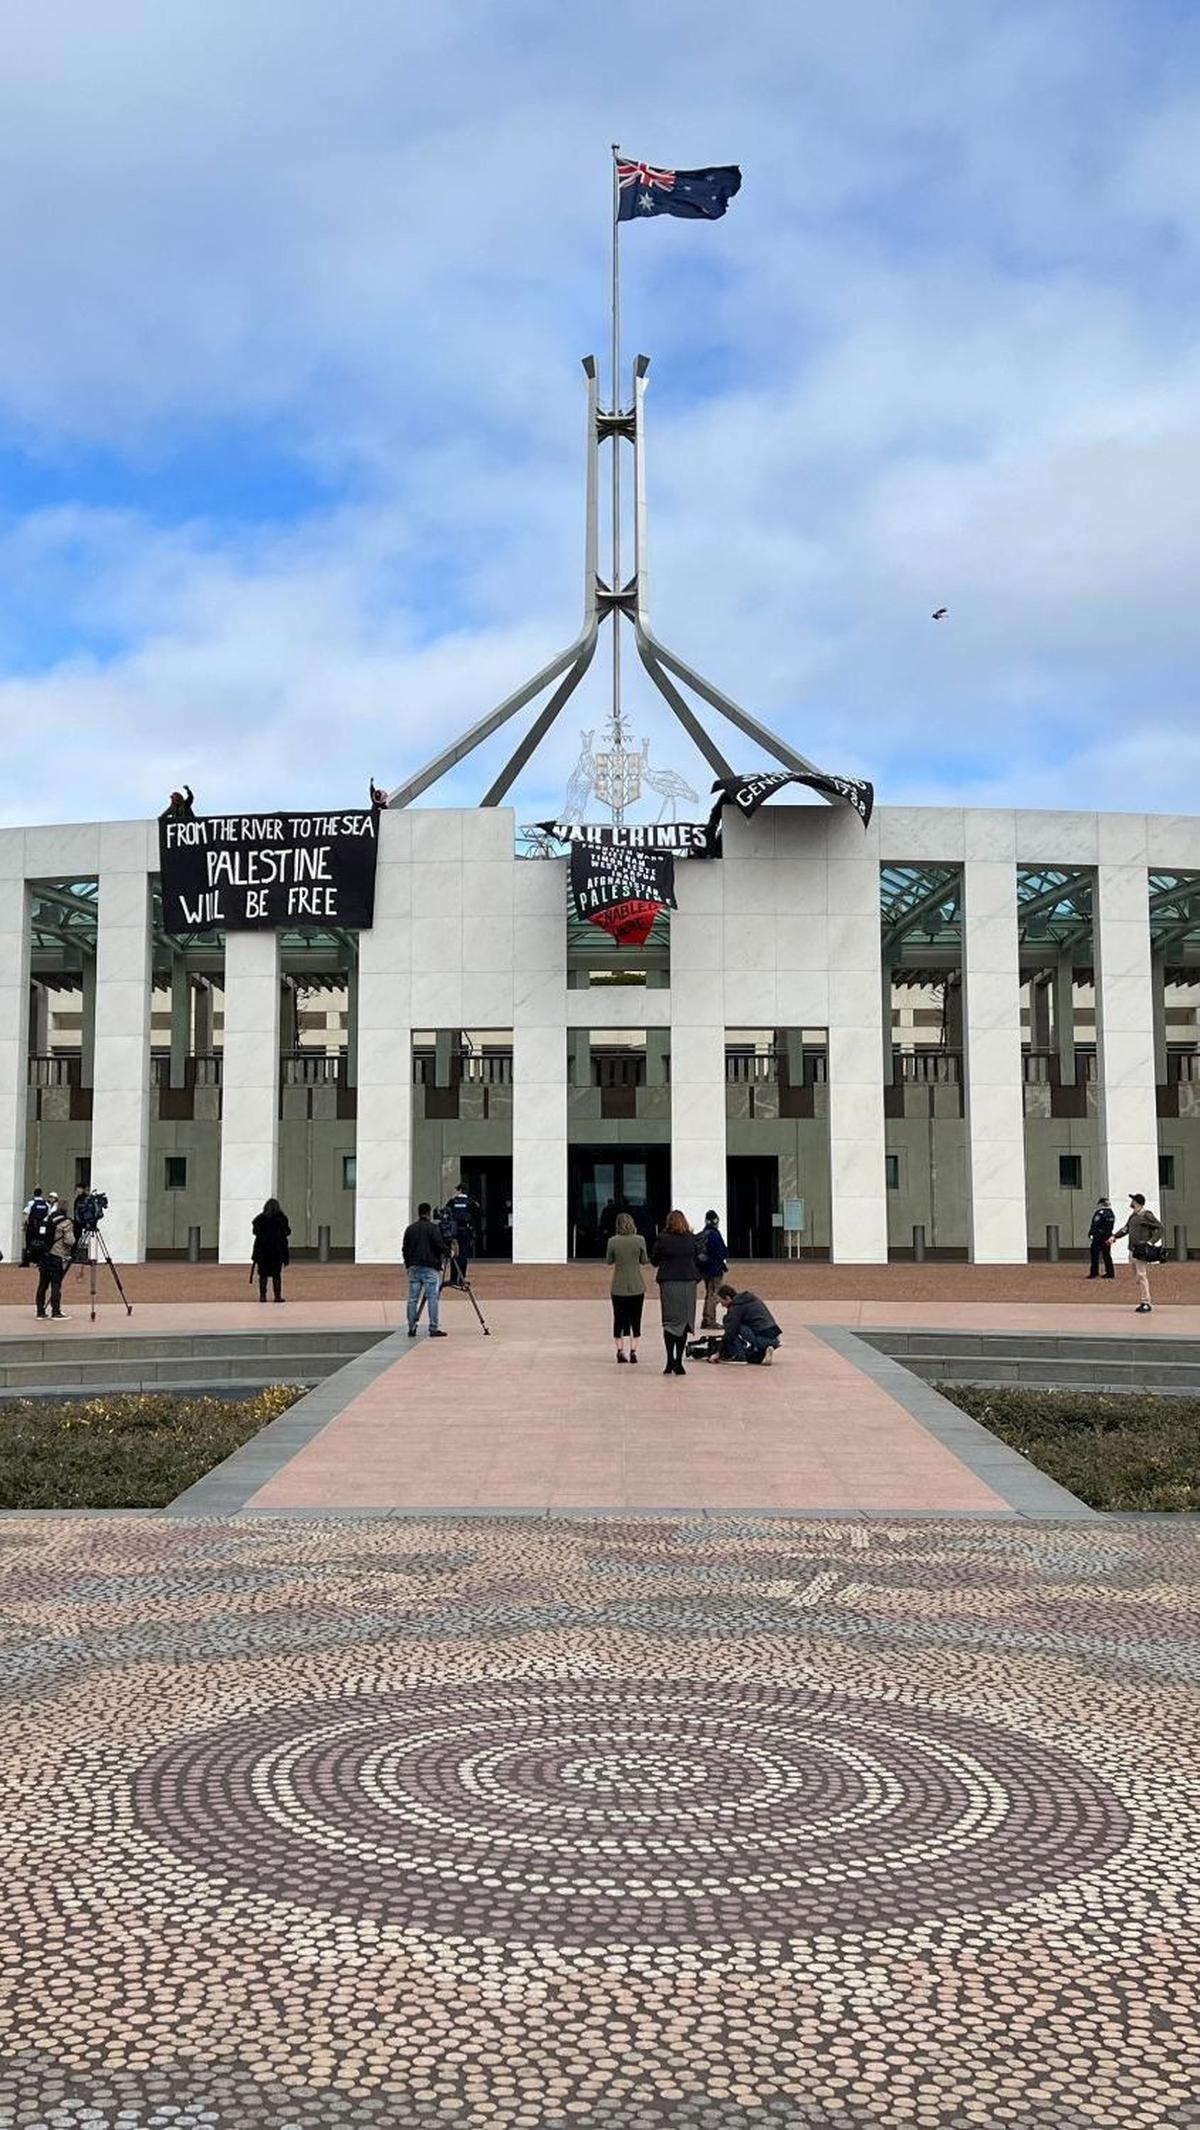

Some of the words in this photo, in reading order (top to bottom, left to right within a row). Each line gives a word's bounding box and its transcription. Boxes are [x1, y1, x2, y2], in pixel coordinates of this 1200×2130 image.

[166, 821, 208, 849] FROM
[208, 818, 239, 841] THE
[241, 818, 284, 841] RIVER
[288, 817, 311, 838] TO
[312, 816, 341, 837] THE
[340, 815, 375, 838] SEA
[552, 825, 601, 844] WAR
[612, 825, 707, 848] CRIMES
[207, 846, 332, 887] PALESTINE
[246, 889, 269, 918] BE
[288, 887, 338, 916] FREE
[602, 902, 658, 922] NABLED
